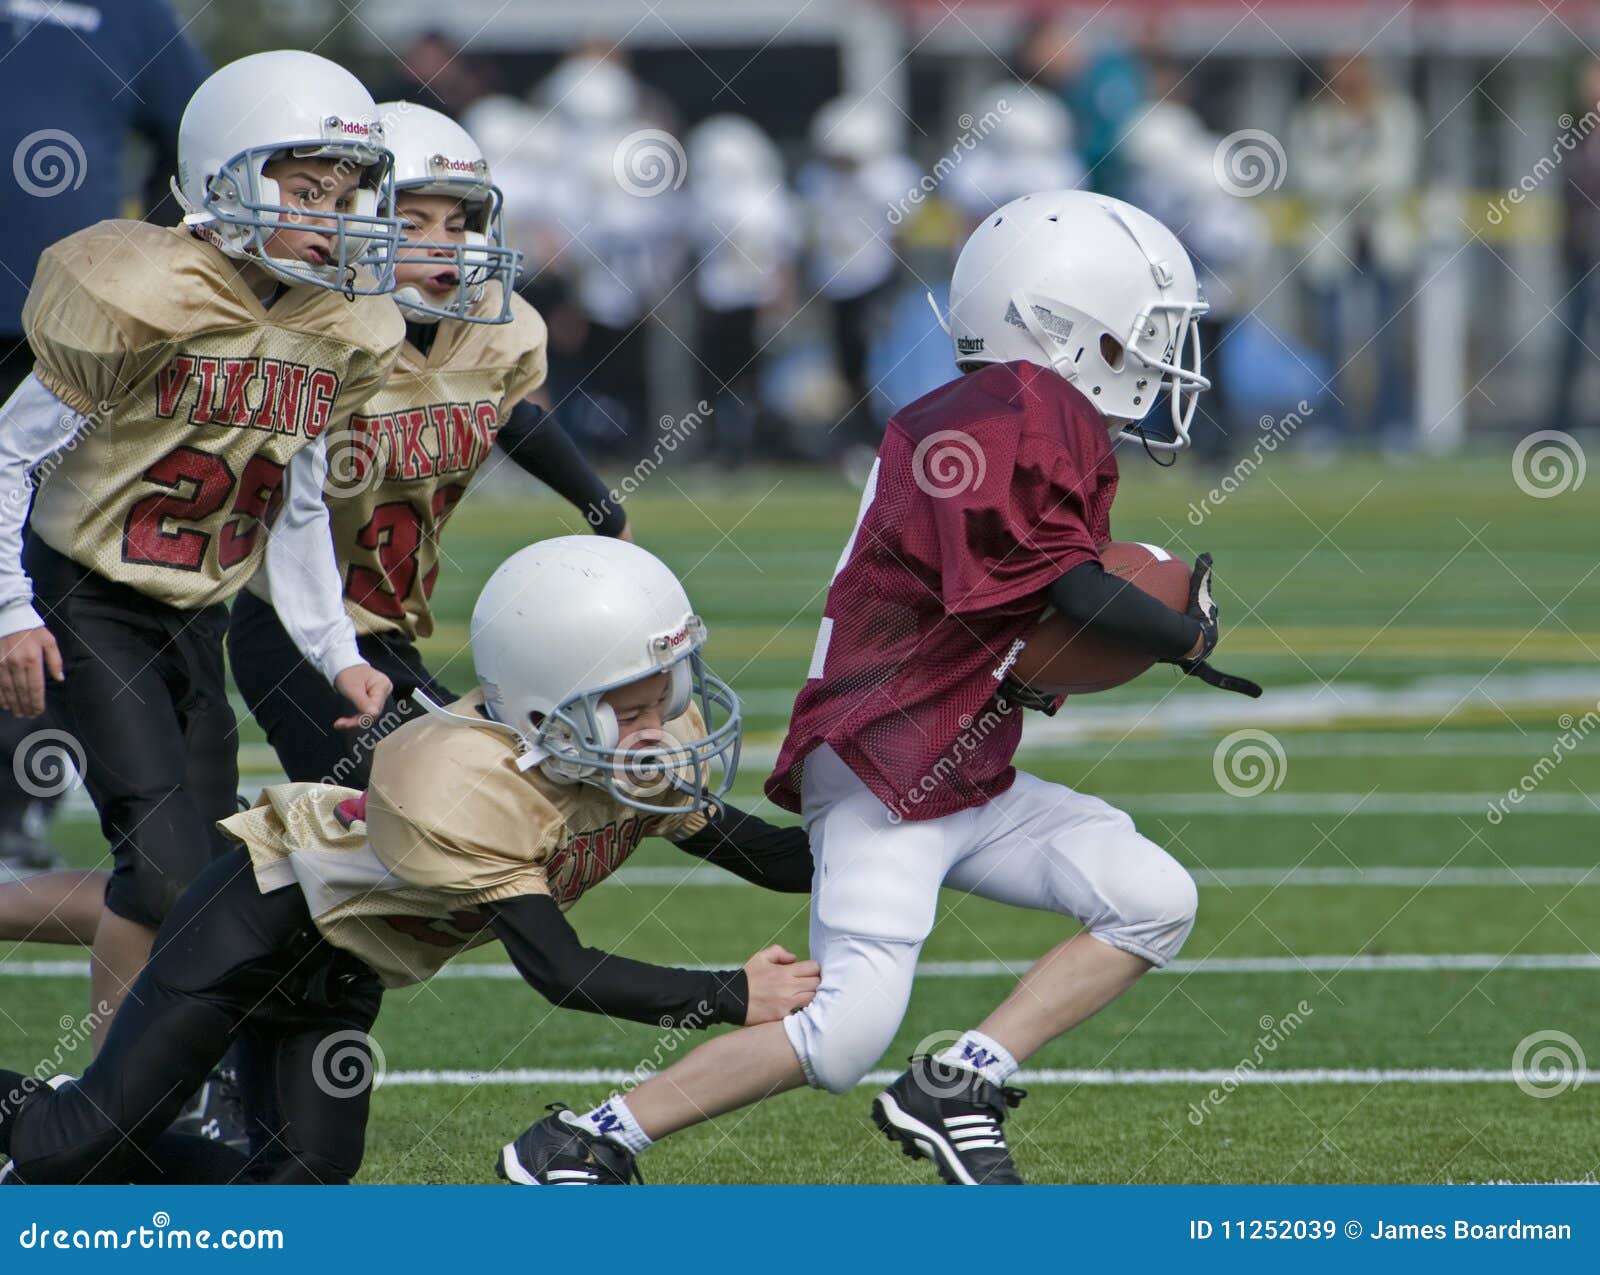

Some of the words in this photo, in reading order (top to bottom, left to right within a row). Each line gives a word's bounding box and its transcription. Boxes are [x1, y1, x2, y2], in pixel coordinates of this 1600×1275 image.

[155, 353, 340, 440] VIKING
[961, 1040, 1000, 1069] W
[590, 1103, 625, 1136] W
